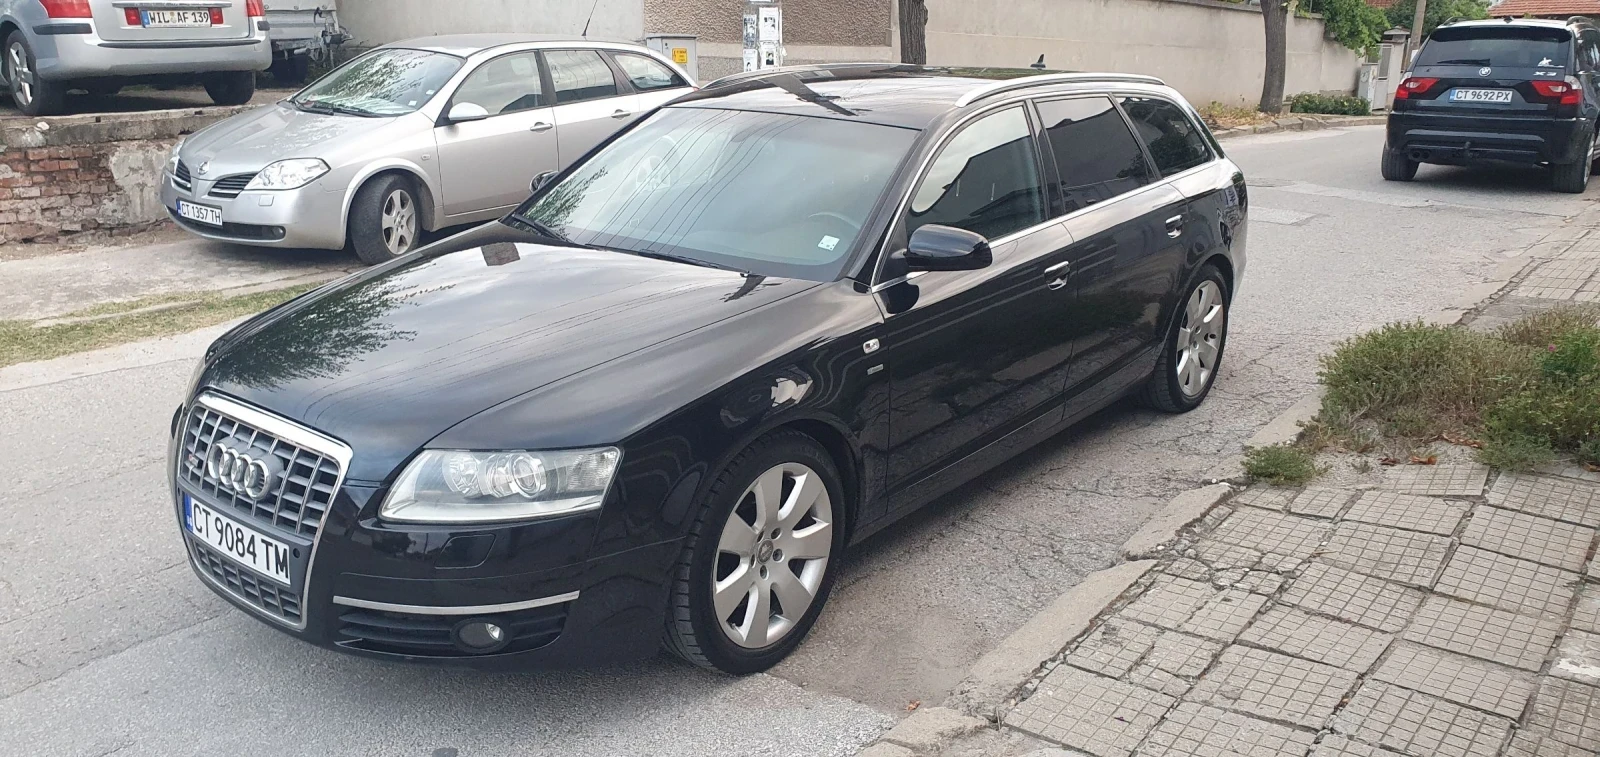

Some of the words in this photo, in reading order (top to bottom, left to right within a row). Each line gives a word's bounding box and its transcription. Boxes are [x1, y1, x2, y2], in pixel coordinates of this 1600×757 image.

[149, 11, 169, 23] WIL
[177, 12, 188, 23] AF
[191, 12, 209, 23] 139
[1456, 90, 1468, 100] CT
[1471, 91, 1495, 101] 9692
[1496, 92, 1511, 101] PX
[182, 203, 190, 216] CT
[192, 206, 209, 221] 1357
[210, 209, 221, 223] TH
[193, 503, 211, 539] CT
[215, 516, 257, 565] 9084
[261, 538, 289, 579] TM
